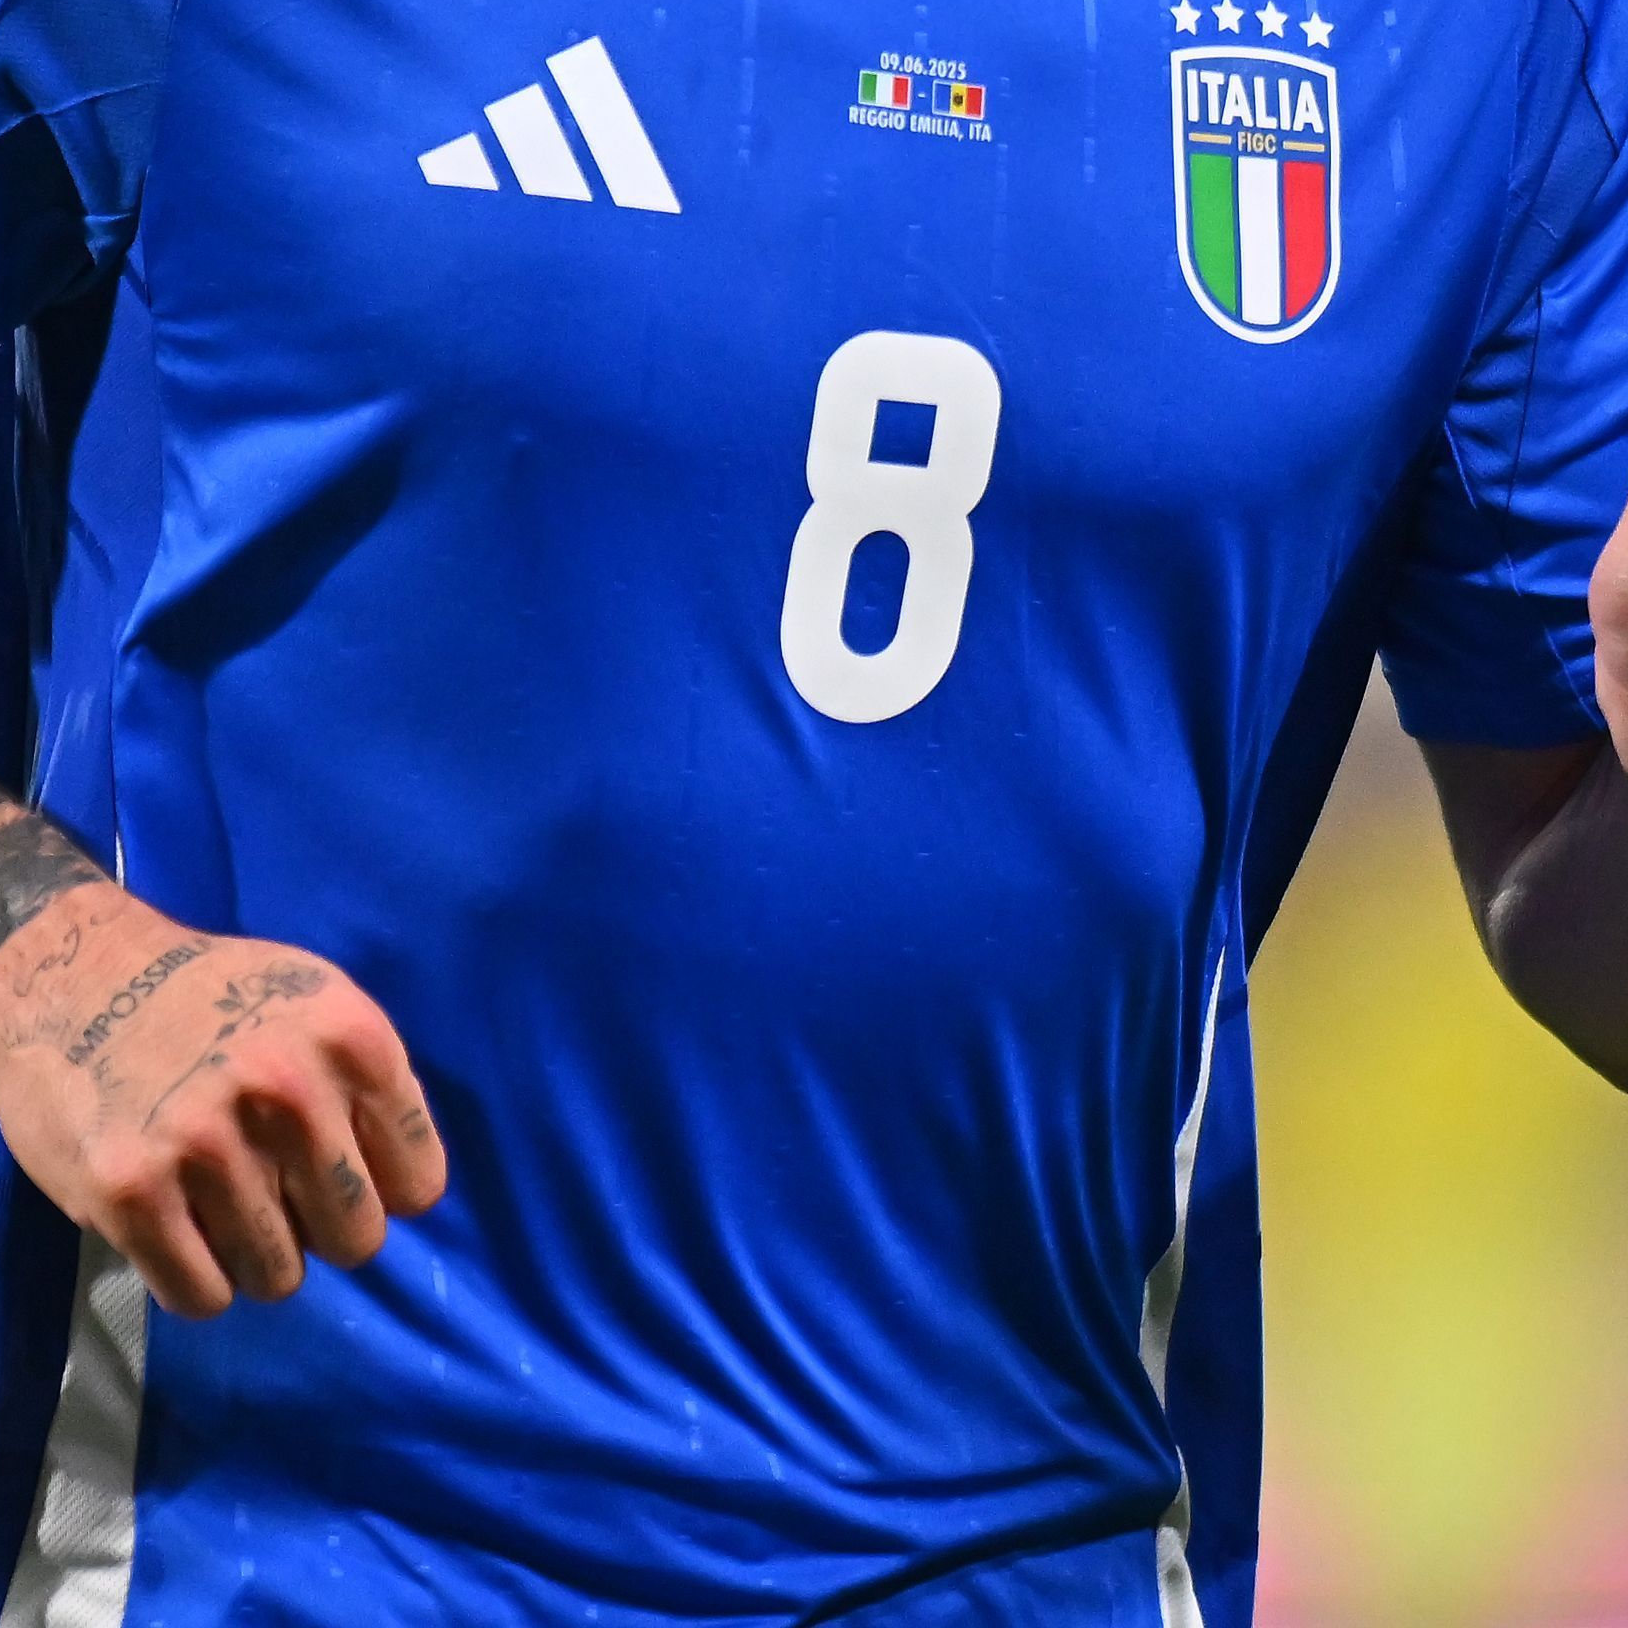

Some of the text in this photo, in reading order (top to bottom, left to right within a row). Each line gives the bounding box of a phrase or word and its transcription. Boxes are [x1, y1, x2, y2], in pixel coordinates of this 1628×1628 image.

[880, 52, 967, 80] 09.06.2025
[1185, 69, 1325, 134] ITALIA
[849, 106, 992, 142] REGGIO EMILIA, ITA
[1237, 131, 1278, 154] FIGC
[780, 330, 1001, 724] 8
